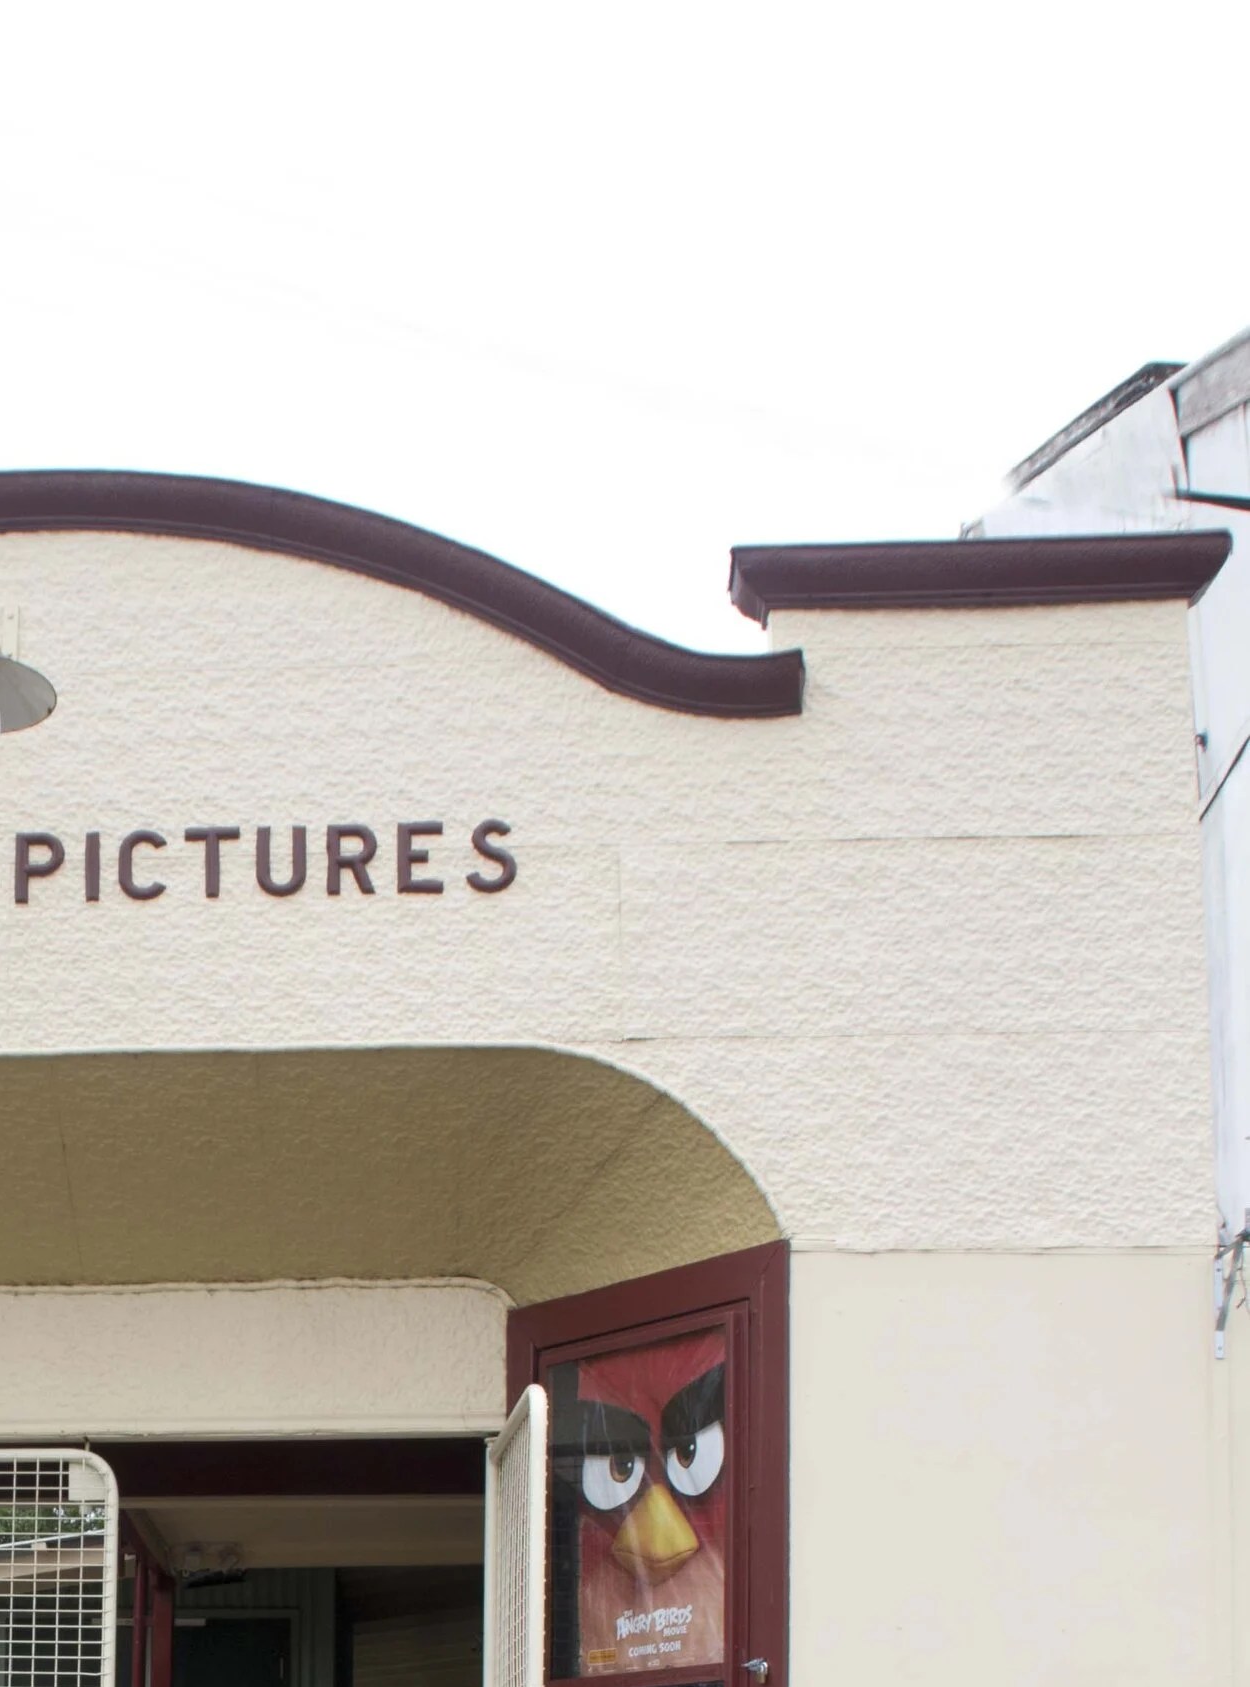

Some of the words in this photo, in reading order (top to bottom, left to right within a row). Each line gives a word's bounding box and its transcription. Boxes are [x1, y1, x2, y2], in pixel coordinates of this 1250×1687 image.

[14, 818, 518, 904] PICTURES
[616, 1614, 651, 1640] ANGRY
[652, 1605, 693, 1631] BIRDS
[663, 1625, 687, 1637] MOVIE
[628, 1643, 658, 1657] COMING
[659, 1640, 681, 1653] SOON
